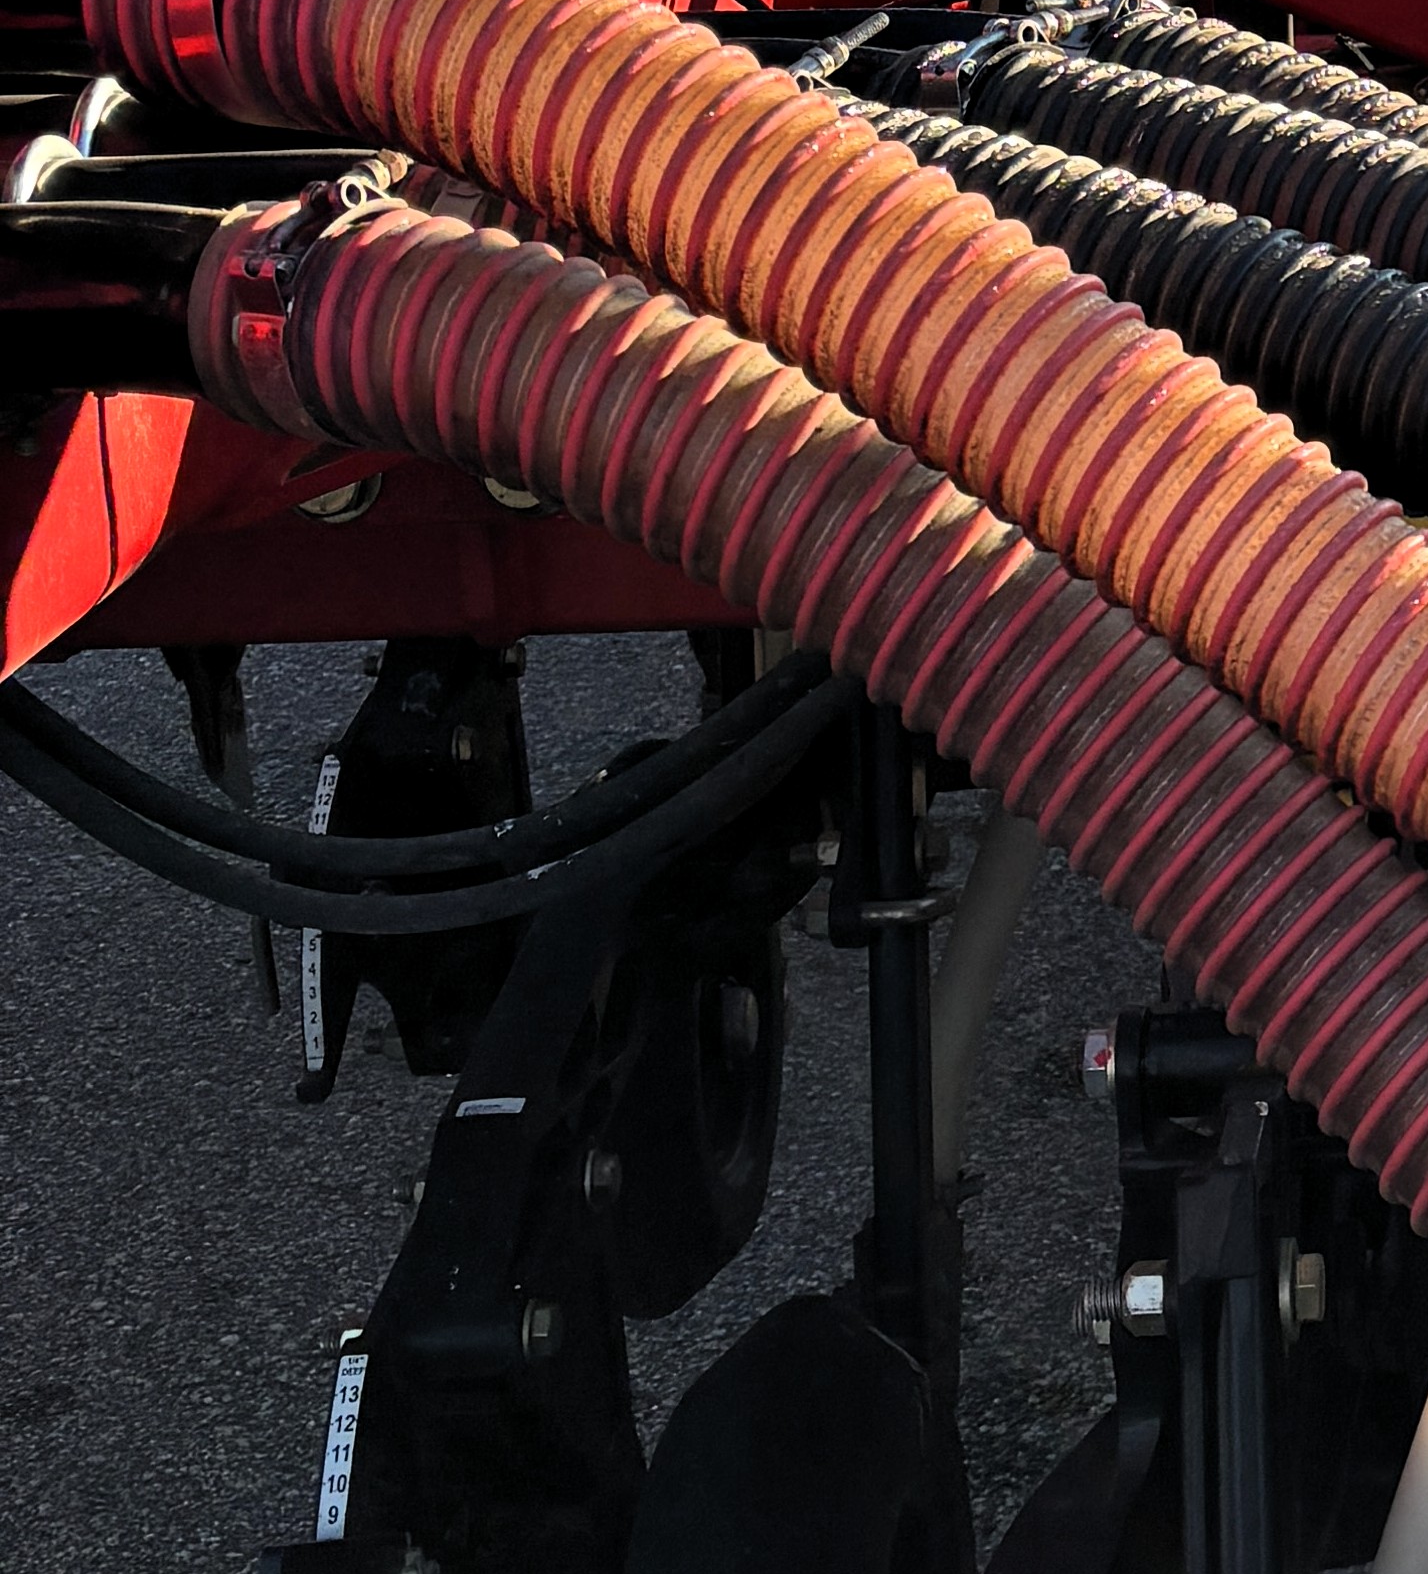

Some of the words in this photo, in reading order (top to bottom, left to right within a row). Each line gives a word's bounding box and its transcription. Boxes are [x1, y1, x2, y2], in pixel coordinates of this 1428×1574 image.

[323, 775, 336, 786] 13
[318, 793, 331, 805] 12
[315, 813, 327, 825] 11
[309, 938, 317, 952] 5
[308, 962, 316, 976] 4
[309, 986, 317, 999] 3
[310, 1011, 318, 1024] 2
[313, 1036, 319, 1049] 1
[339, 1385, 360, 1404] 13
[335, 1414, 356, 1433] 12
[332, 1443, 350, 1463] 11
[328, 1474, 347, 1494] 10
[328, 1505, 339, 1525] 9
